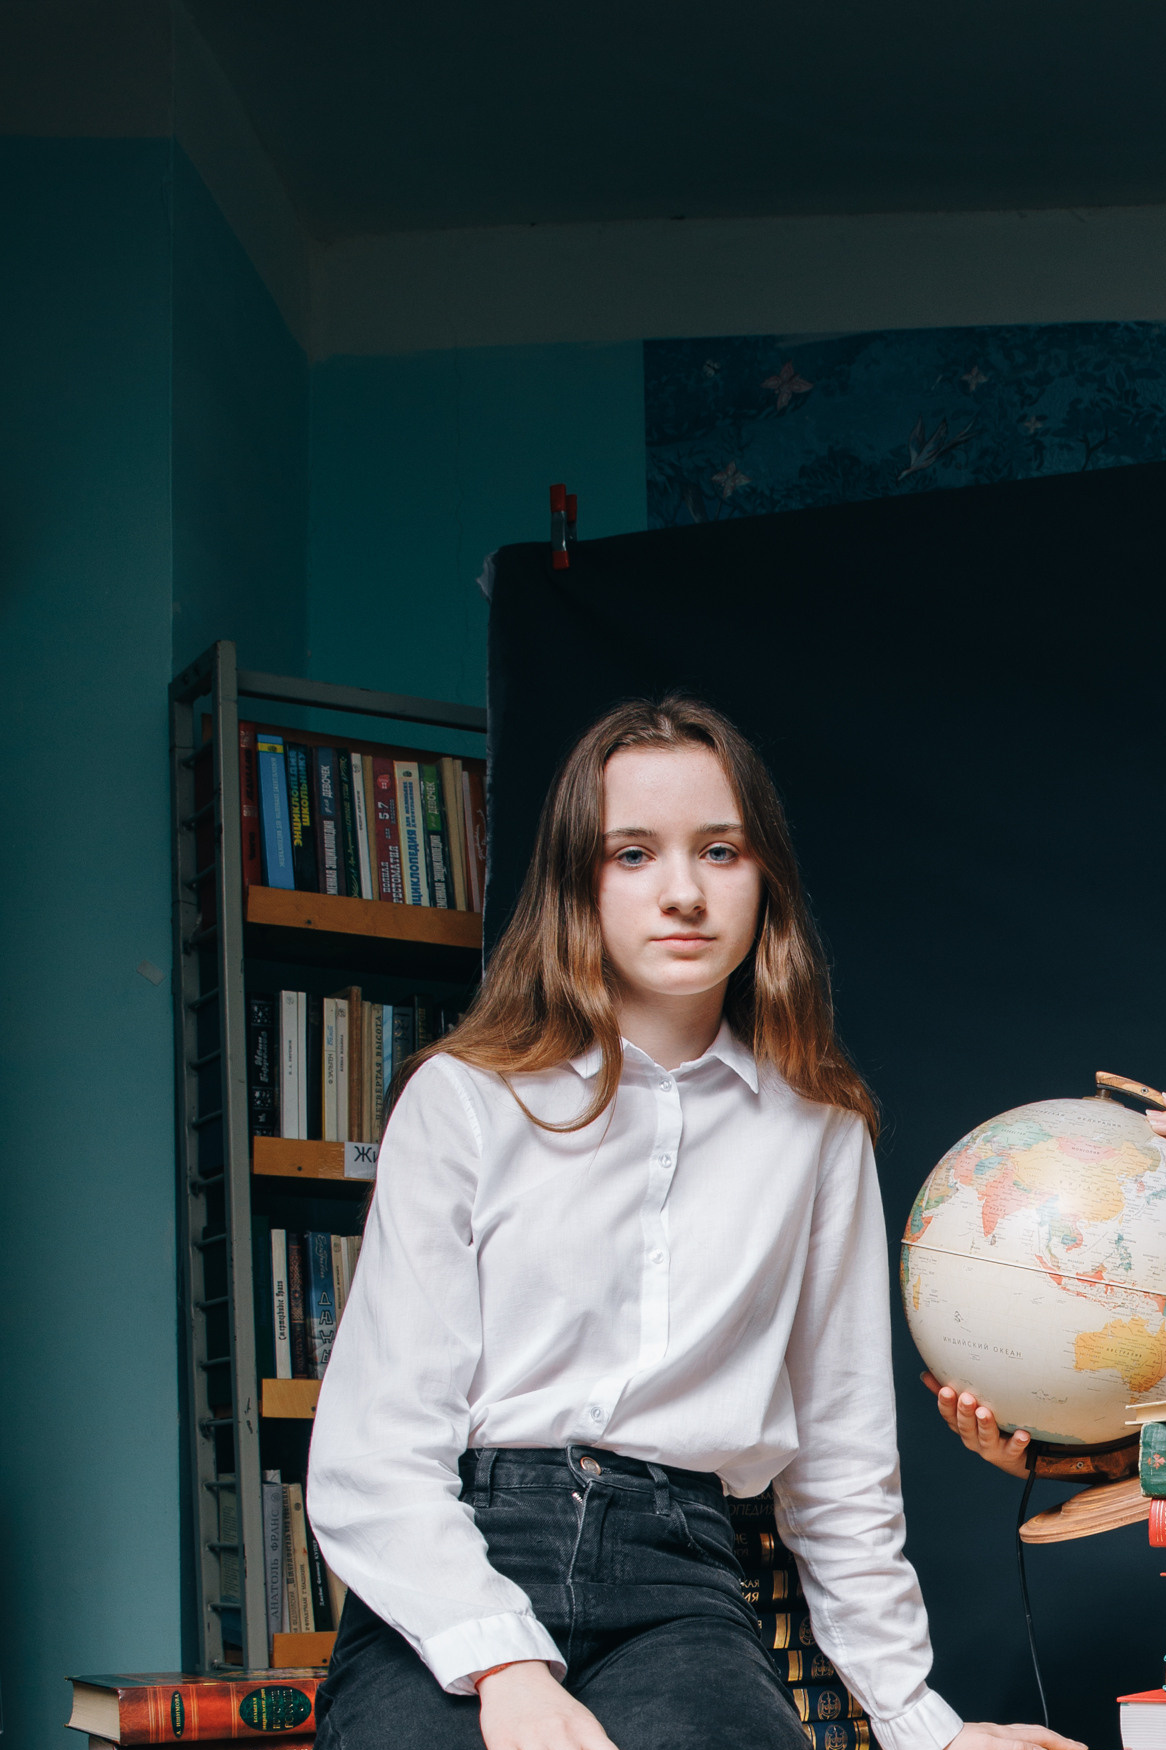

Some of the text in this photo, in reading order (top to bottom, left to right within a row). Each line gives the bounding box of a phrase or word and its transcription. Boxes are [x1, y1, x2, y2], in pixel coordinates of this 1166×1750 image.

[321, 765, 333, 798] ДЕВОЧЕК
[426, 781, 438, 814] ДЕВОЧЕК
[289, 751, 303, 847] ЭНЦИКЛОПЕДИЯ
[323, 820, 337, 869] ЭНЦИКЛОПЕДИЯ
[326, 870, 338, 895] МЕННАЯ
[381, 862, 391, 893] ПОЛНАЯ
[389, 845, 403, 903] РЕСТОМАТИЯ
[407, 829, 422, 905] ЦИКЛОПЕДИЯ
[434, 882, 448, 909] ЕМЕННАЯ
[943, 1336, 1022, 1357] ИНДИЙСКИЙ ОКЕАН
[270, 1510, 280, 1619] АНАТОЛЬ ФРАНС
